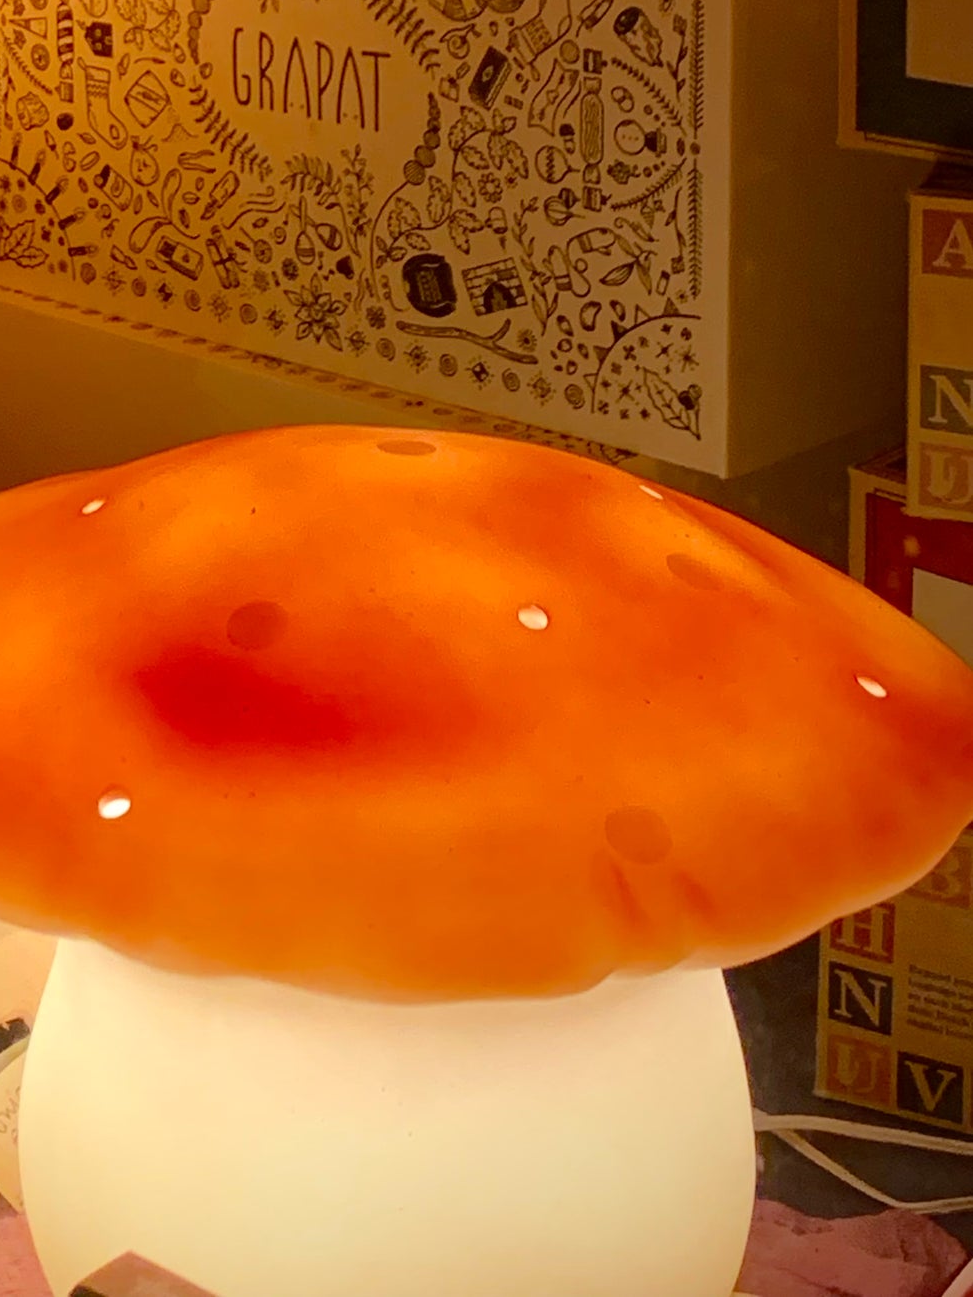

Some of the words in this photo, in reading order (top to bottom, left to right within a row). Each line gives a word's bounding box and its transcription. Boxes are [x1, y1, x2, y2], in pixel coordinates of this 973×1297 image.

[232, 27, 392, 132] GRAPAT
[833, 967, 888, 1028] N
[904, 1058, 959, 1113] V
